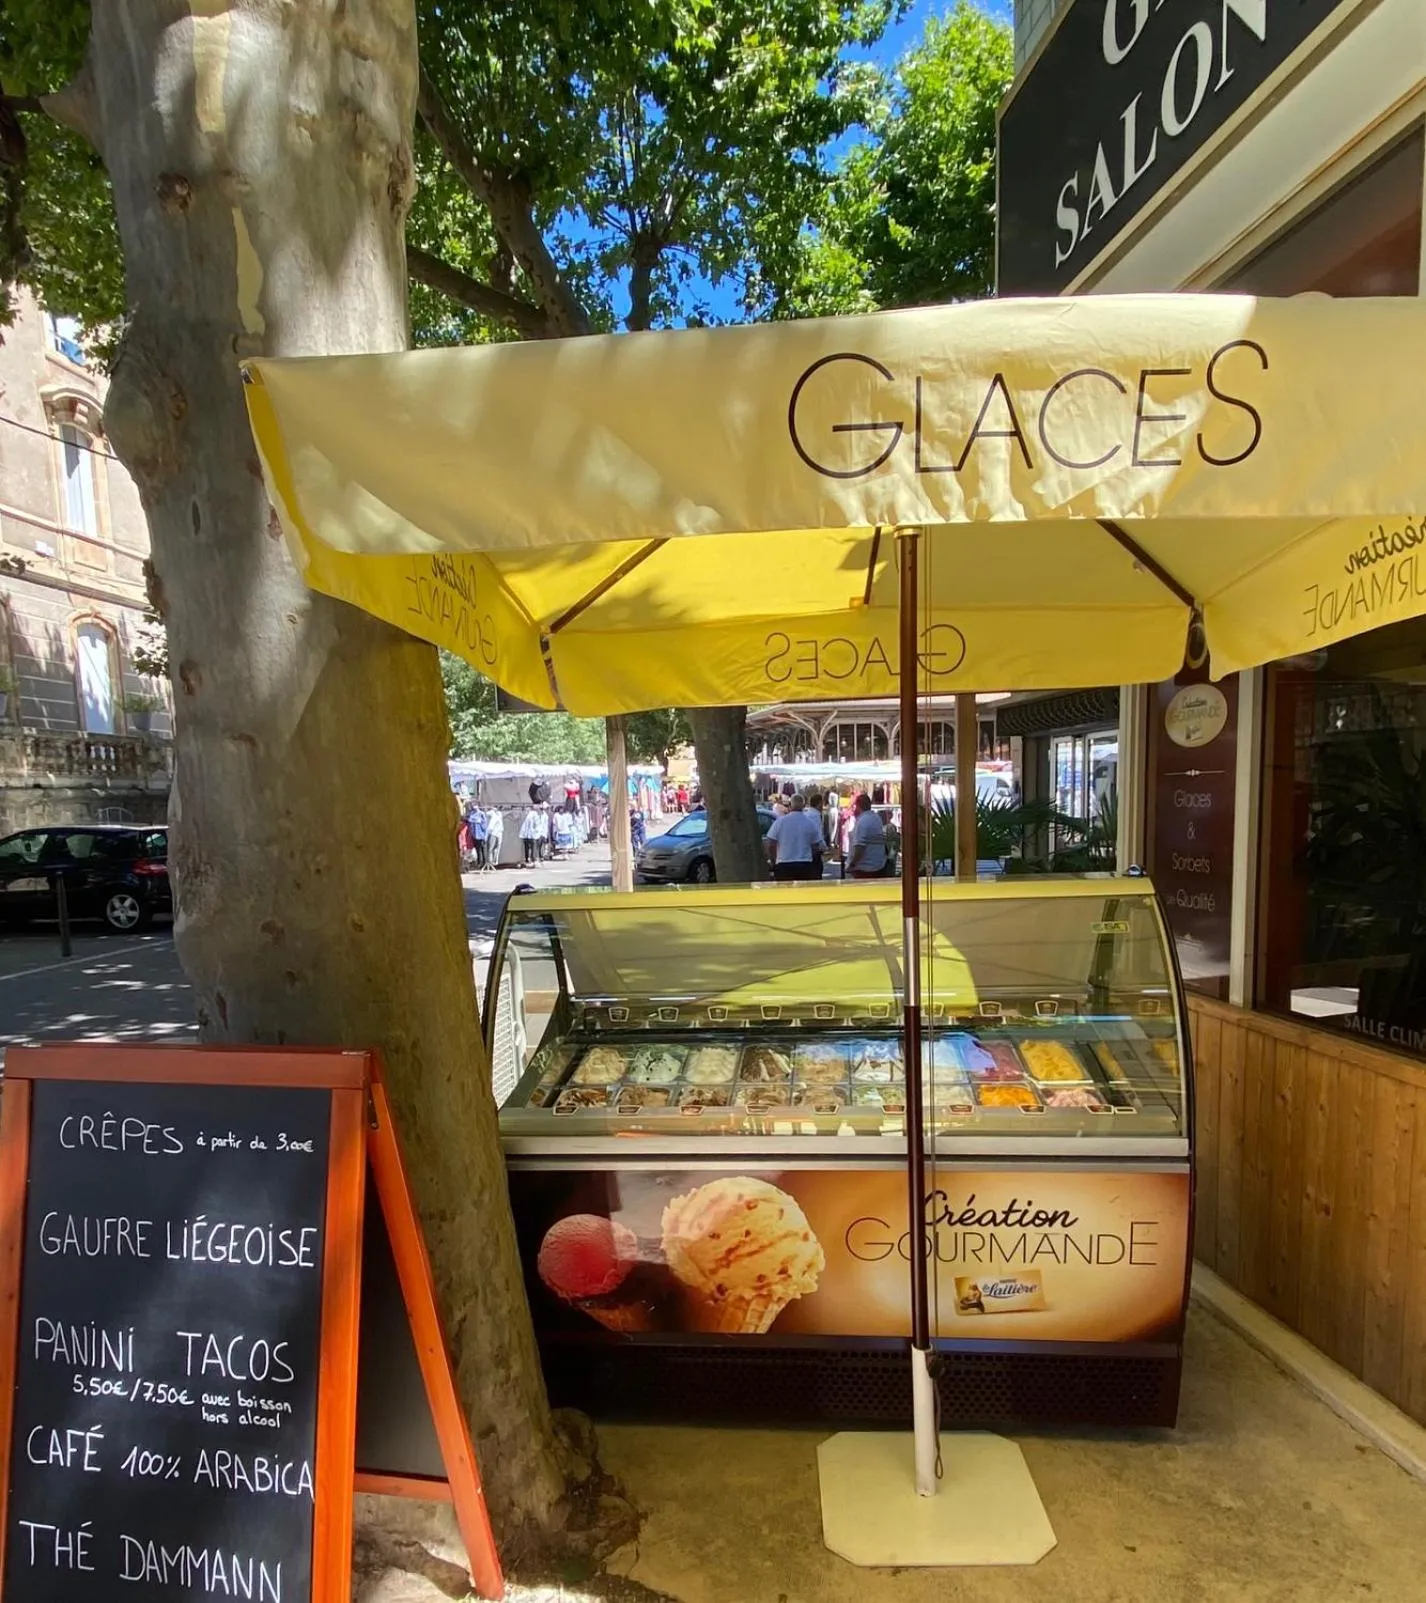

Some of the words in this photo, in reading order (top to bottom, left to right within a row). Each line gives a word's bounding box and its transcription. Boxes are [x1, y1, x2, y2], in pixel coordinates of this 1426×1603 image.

[1056, 0, 1267, 269] SALON
[788, 339, 1269, 479] GLACES
[1186, 821, 1196, 840] &
[1344, 1013, 1386, 1038] SALLE
[60, 1111, 184, 1154] CRÊPES
[211, 1131, 242, 1152] partir
[250, 1135, 268, 1149] de
[924, 1188, 1079, 1228] Création
[39, 1211, 152, 1257] GAUFRE
[845, 1217, 1159, 1265] GOURMANDE
[177, 1331, 294, 1382] TACOS
[201, 1393, 231, 1407] avec
[237, 1390, 292, 1413] boisson
[202, 1406, 229, 1424] hors
[239, 1411, 281, 1428] alcool
[27, 1425, 104, 1471] CAFÉ
[121, 1446, 181, 1479] 100%
[19, 1520, 95, 1570] THÉ
[119, 1534, 281, 1603] DAMMANN
